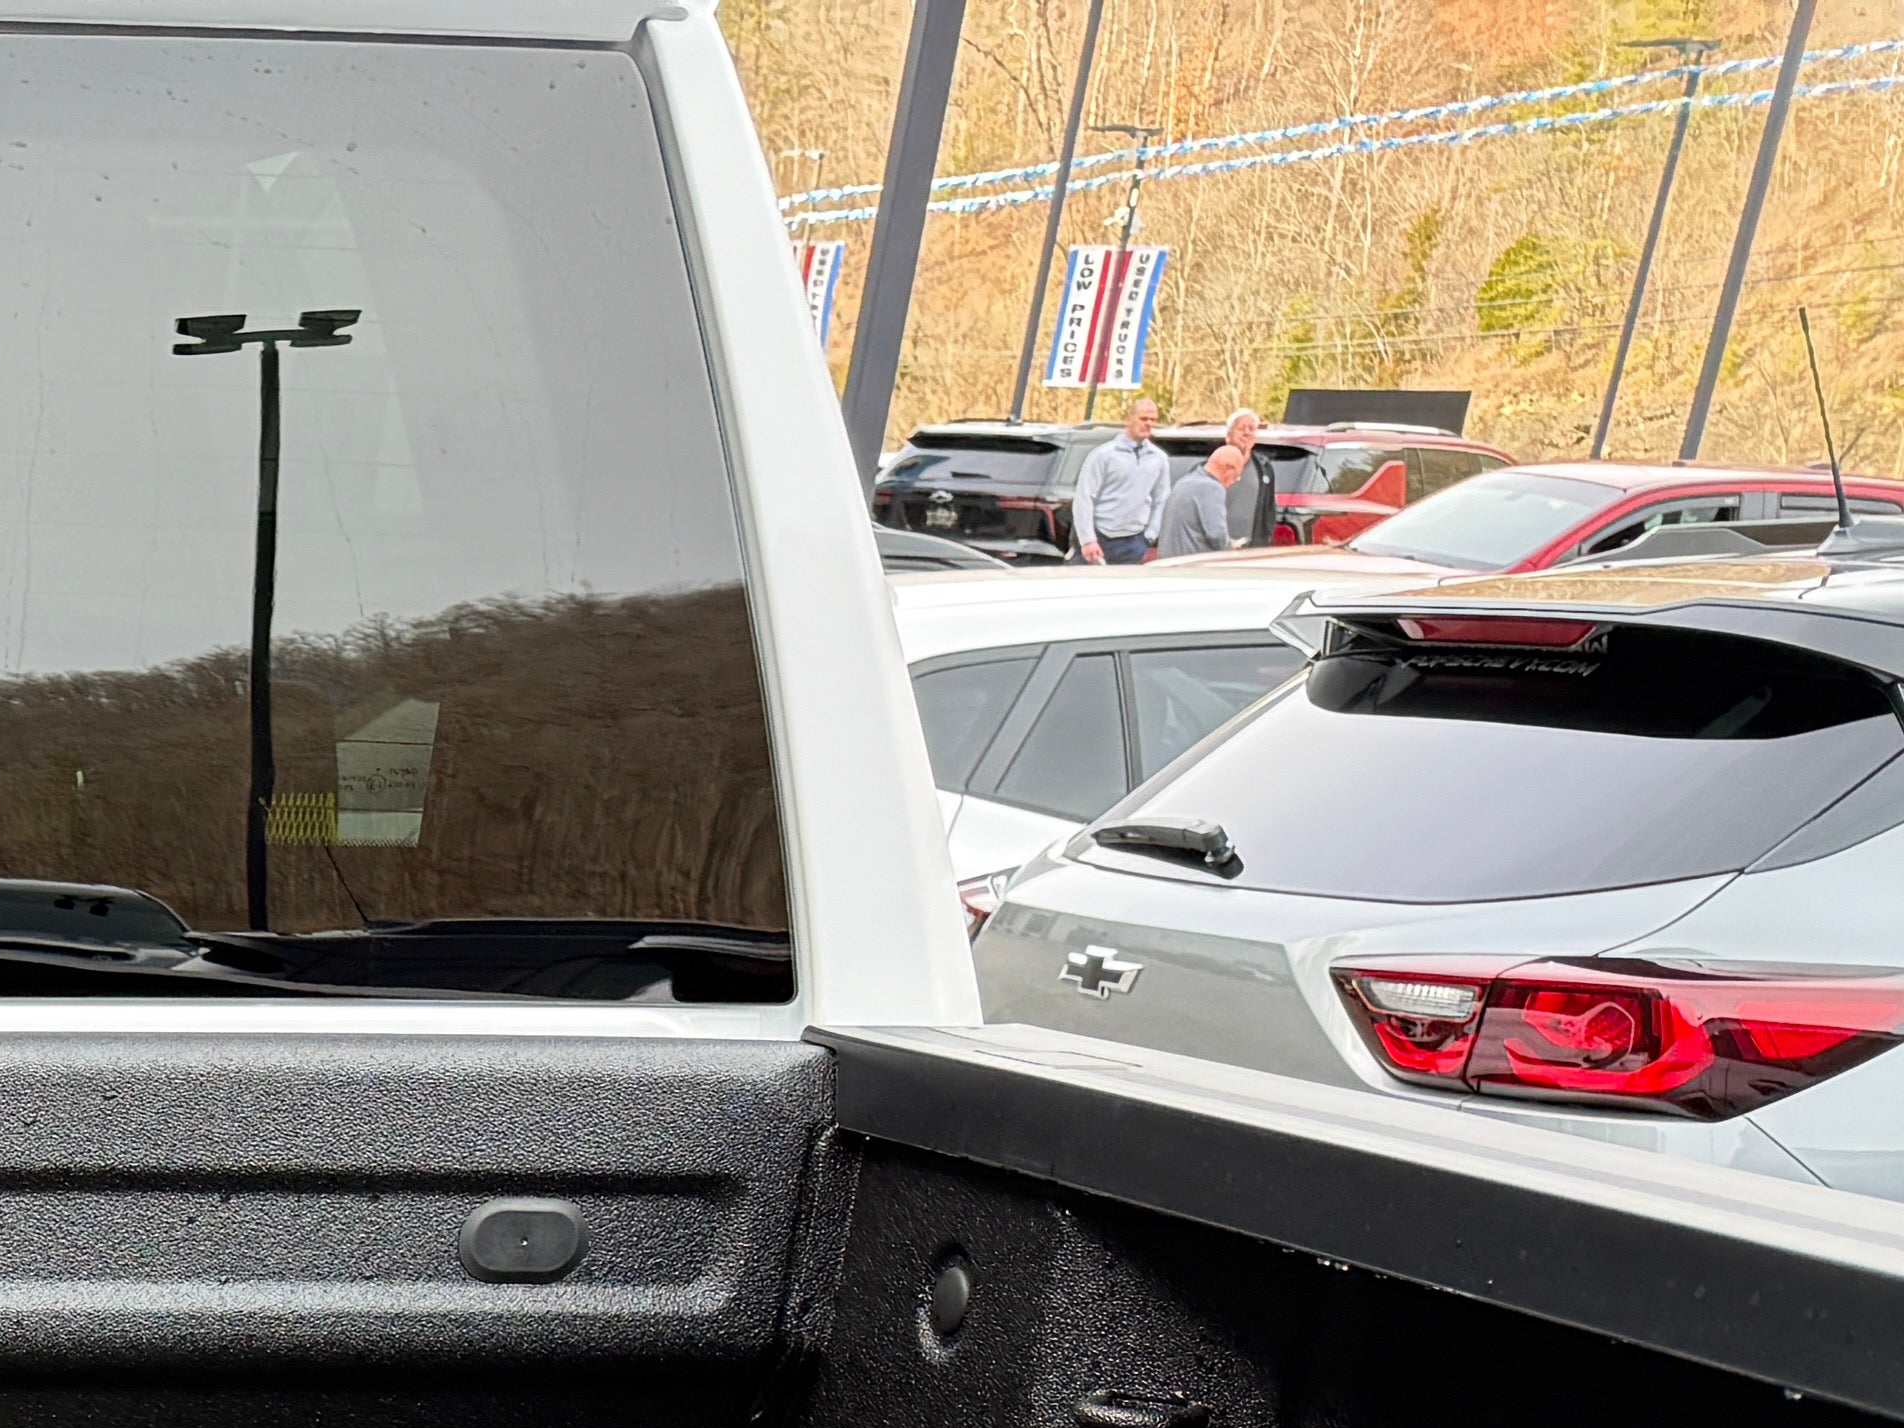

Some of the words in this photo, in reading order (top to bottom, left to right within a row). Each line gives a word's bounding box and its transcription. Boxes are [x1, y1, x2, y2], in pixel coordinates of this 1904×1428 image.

[1075, 253, 1095, 291] LOW
[1128, 253, 1151, 301] USED
[1059, 303, 1085, 379] PRICES
[1114, 307, 1134, 379] TRUCKS
